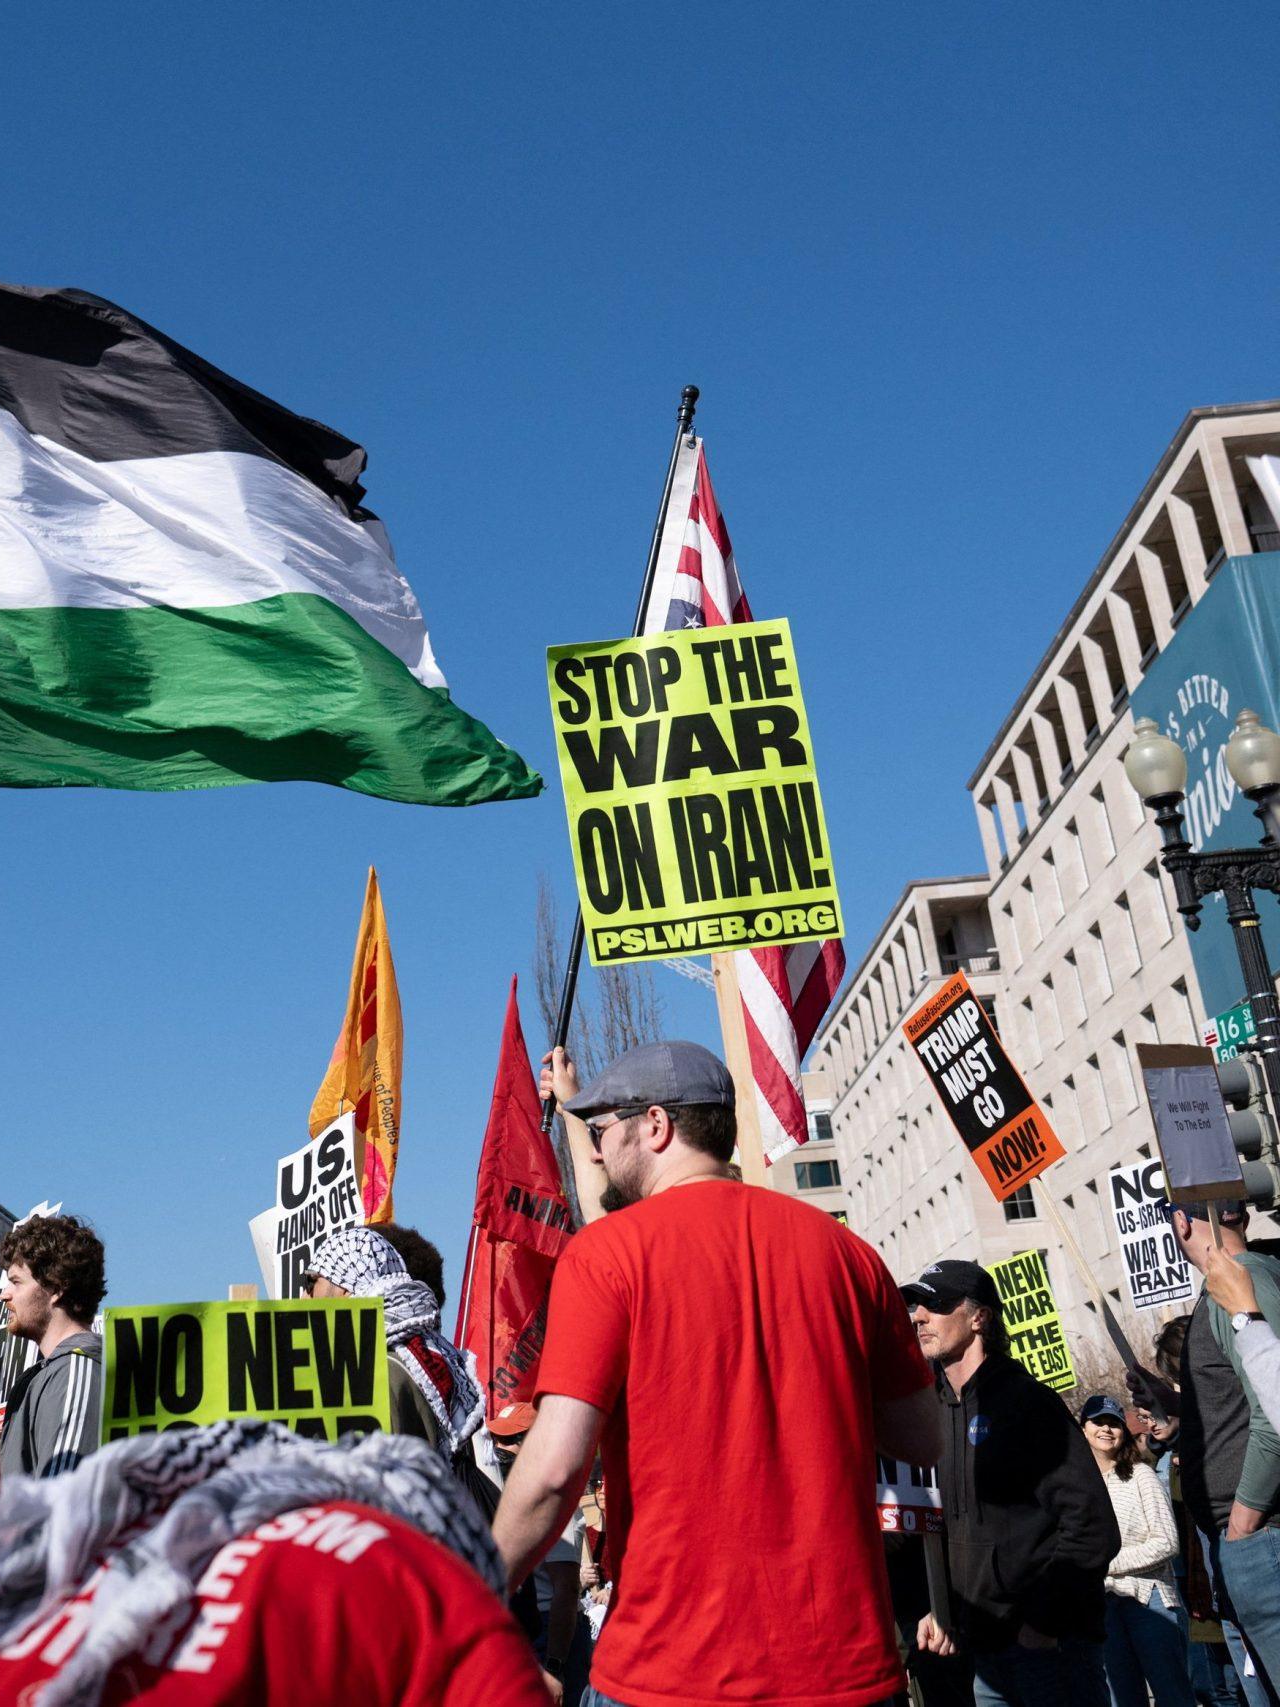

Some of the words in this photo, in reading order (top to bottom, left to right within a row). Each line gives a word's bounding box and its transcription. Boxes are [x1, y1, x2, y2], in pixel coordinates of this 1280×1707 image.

[555, 646, 681, 725] STOP
[691, 633, 793, 706] THE
[1177, 674, 1229, 719] BETTER
[562, 705, 807, 793] WAR
[1186, 728, 1198, 752] IN
[1197, 720, 1206, 740] A
[577, 802, 666, 915] ON
[668, 781, 831, 904] IRAN!
[596, 906, 836, 956] PSLWEB.ORG
[908, 981, 964, 1037] RefuseFascism.org
[1219, 1016, 1240, 1041] 16
[917, 1000, 979, 1072] TRUMP
[941, 1037, 997, 1104] MUST
[378, 1098, 399, 1146] Peoples
[973, 1085, 1005, 1128] GO
[1167, 1102, 1178, 1113] We
[1178, 1101, 1192, 1112] Will
[1192, 1100, 1210, 1114] Fight
[1175, 1121, 1184, 1131] To
[1184, 1119, 1198, 1130] The
[1199, 1118, 1211, 1129] End
[281, 1129, 352, 1210] U.S.
[987, 1117, 1047, 1183] NOW!
[1111, 1161, 1166, 1210] NO
[276, 1193, 325, 1254] HANDS
[328, 1175, 357, 1225] OFF
[505, 1185, 574, 1236] ANAK
[1116, 1204, 1171, 1235] US-ISRA
[994, 1253, 1044, 1300] NEW
[1124, 1236, 1159, 1274] WAR
[1129, 1262, 1190, 1295] IRAN!
[1002, 1289, 1055, 1326] WAR
[1012, 1320, 1062, 1354] THE
[1037, 1344, 1068, 1376] EAST
[112, 1313, 204, 1419] NO
[227, 1308, 378, 1412] NEW
